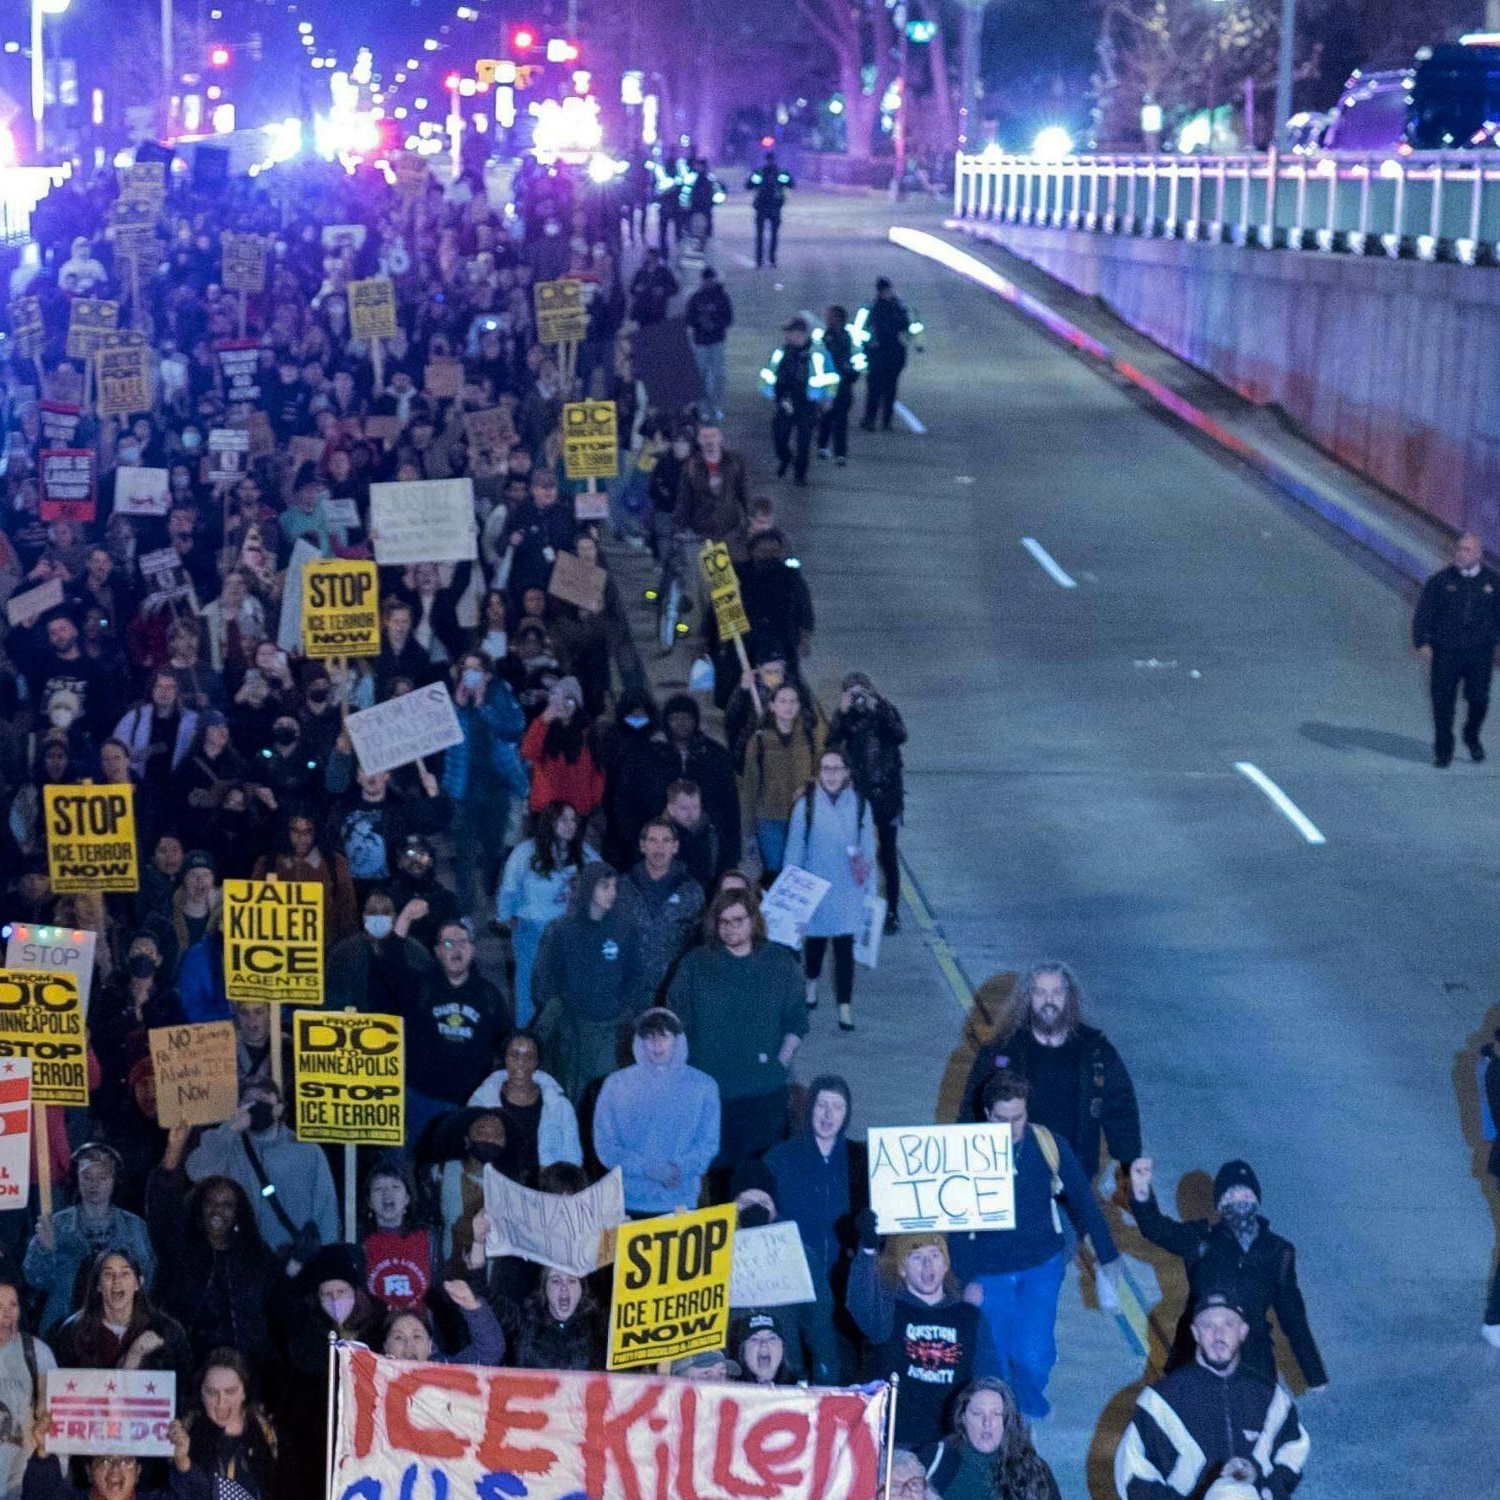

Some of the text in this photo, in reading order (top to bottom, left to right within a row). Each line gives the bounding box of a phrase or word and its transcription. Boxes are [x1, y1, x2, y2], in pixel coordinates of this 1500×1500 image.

[310, 572, 373, 608] STOP
[307, 612, 374, 631] ICE TERROR
[312, 632, 373, 645] NOW
[53, 795, 127, 837] STOP
[52, 843, 131, 862] ICE TERROR
[58, 863, 130, 877] NOW
[230, 883, 319, 905] JAIL
[230, 905, 318, 941] KILLER
[21, 943, 80, 966] STOP
[232, 946, 319, 973] ICE
[10, 973, 51, 983] FROM
[231, 973, 319, 987] AGENTS
[323, 1017, 372, 1028] FROM
[300, 1019, 399, 1055] DC
[31, 1062, 84, 1087] ERROR
[300, 1053, 398, 1077] MINNEAPOLIS
[300, 1082, 399, 1100] STOP
[300, 1101, 400, 1127] ICE TERROR
[874, 1133, 1011, 1178] ABOLISH
[893, 1175, 1010, 1221] ICE
[625, 1216, 729, 1290] STOP
[616, 1283, 725, 1330] ICE TERROR
[621, 1312, 720, 1349] NOW
[905, 1322, 958, 1344] QUESTION
[348, 1348, 560, 1475] ICE
[49, 1420, 171, 1441] FREE DC
